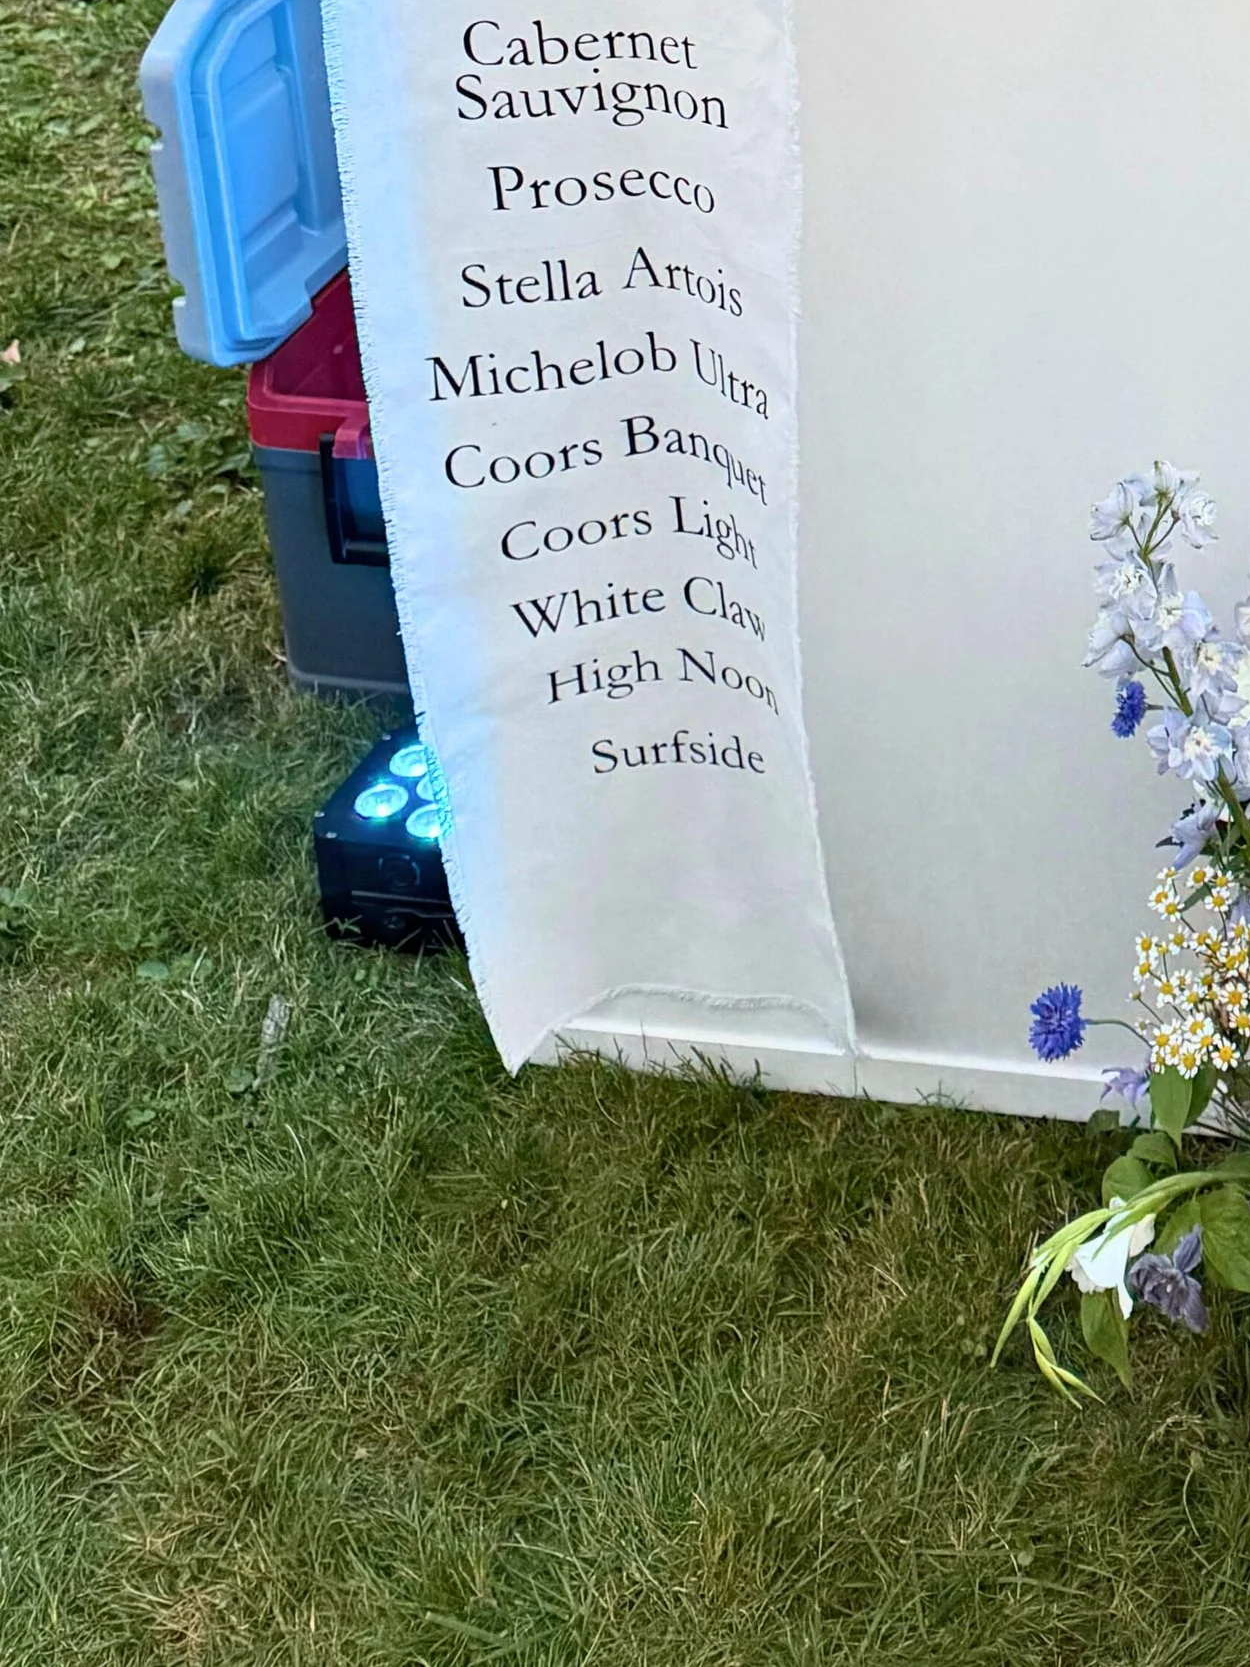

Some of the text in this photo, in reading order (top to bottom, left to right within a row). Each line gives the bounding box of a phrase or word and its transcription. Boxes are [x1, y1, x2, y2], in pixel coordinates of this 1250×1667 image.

[462, 19, 698, 70] Cabernet
[455, 66, 729, 130] Sauvignon
[486, 165, 715, 214] Prosecco
[461, 246, 743, 318] Stella Artois
[424, 330, 769, 421] Michelob Ultra
[444, 414, 769, 506] Coors Banquet
[500, 495, 758, 570] Coors Light
[509, 576, 766, 642] White Claw
[546, 647, 779, 716] High Noon
[591, 729, 766, 774] Surfside
